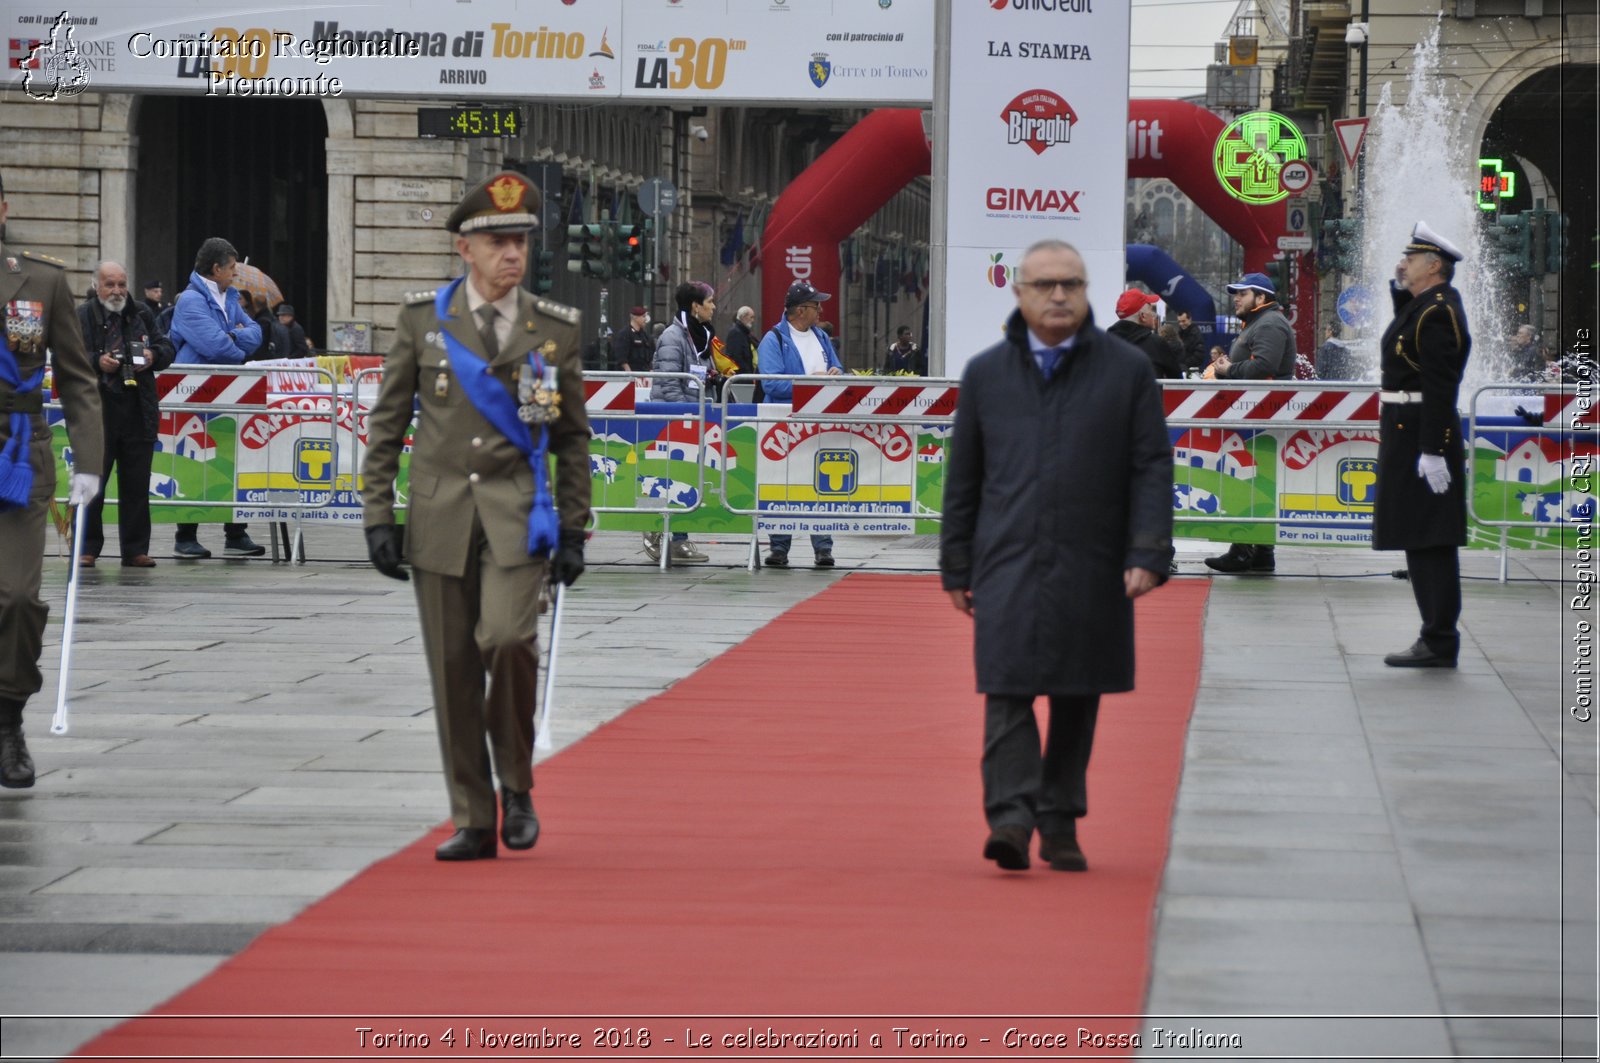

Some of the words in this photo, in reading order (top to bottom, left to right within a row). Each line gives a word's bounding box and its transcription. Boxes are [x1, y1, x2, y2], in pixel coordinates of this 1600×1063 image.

[18, 15, 35, 24] con
[36, 15, 43, 24] il
[89, 16, 98, 26] di
[452, 30, 485, 58] di
[491, 22, 585, 60] Torino
[826, 32, 842, 41] con
[843, 32, 850, 41] il
[850, 32, 894, 43] patrocinio
[895, 32, 904, 42] di
[728, 38, 747, 51] km
[987, 40, 1012, 57] LA
[1018, 42, 1092, 61] STAMPA
[439, 68, 487, 85] ARRIVO
[1007, 109, 1071, 147] Biraghi
[985, 187, 1081, 213] GIMAX
[338, 491, 349, 504] di
[236, 509, 255, 518] Per
[258, 509, 275, 518] noi
[278, 509, 288, 518] la
[332, 510, 339, 520] è
[757, 522, 776, 531] Per
[779, 522, 796, 531] noi
[800, 522, 809, 531] la
[812, 522, 850, 532] qualità
[853, 522, 860, 531] è
[863, 522, 911, 532] centrale.
[1279, 530, 1298, 540] Per
[1302, 531, 1319, 540] noi
[1322, 532, 1332, 541] la
